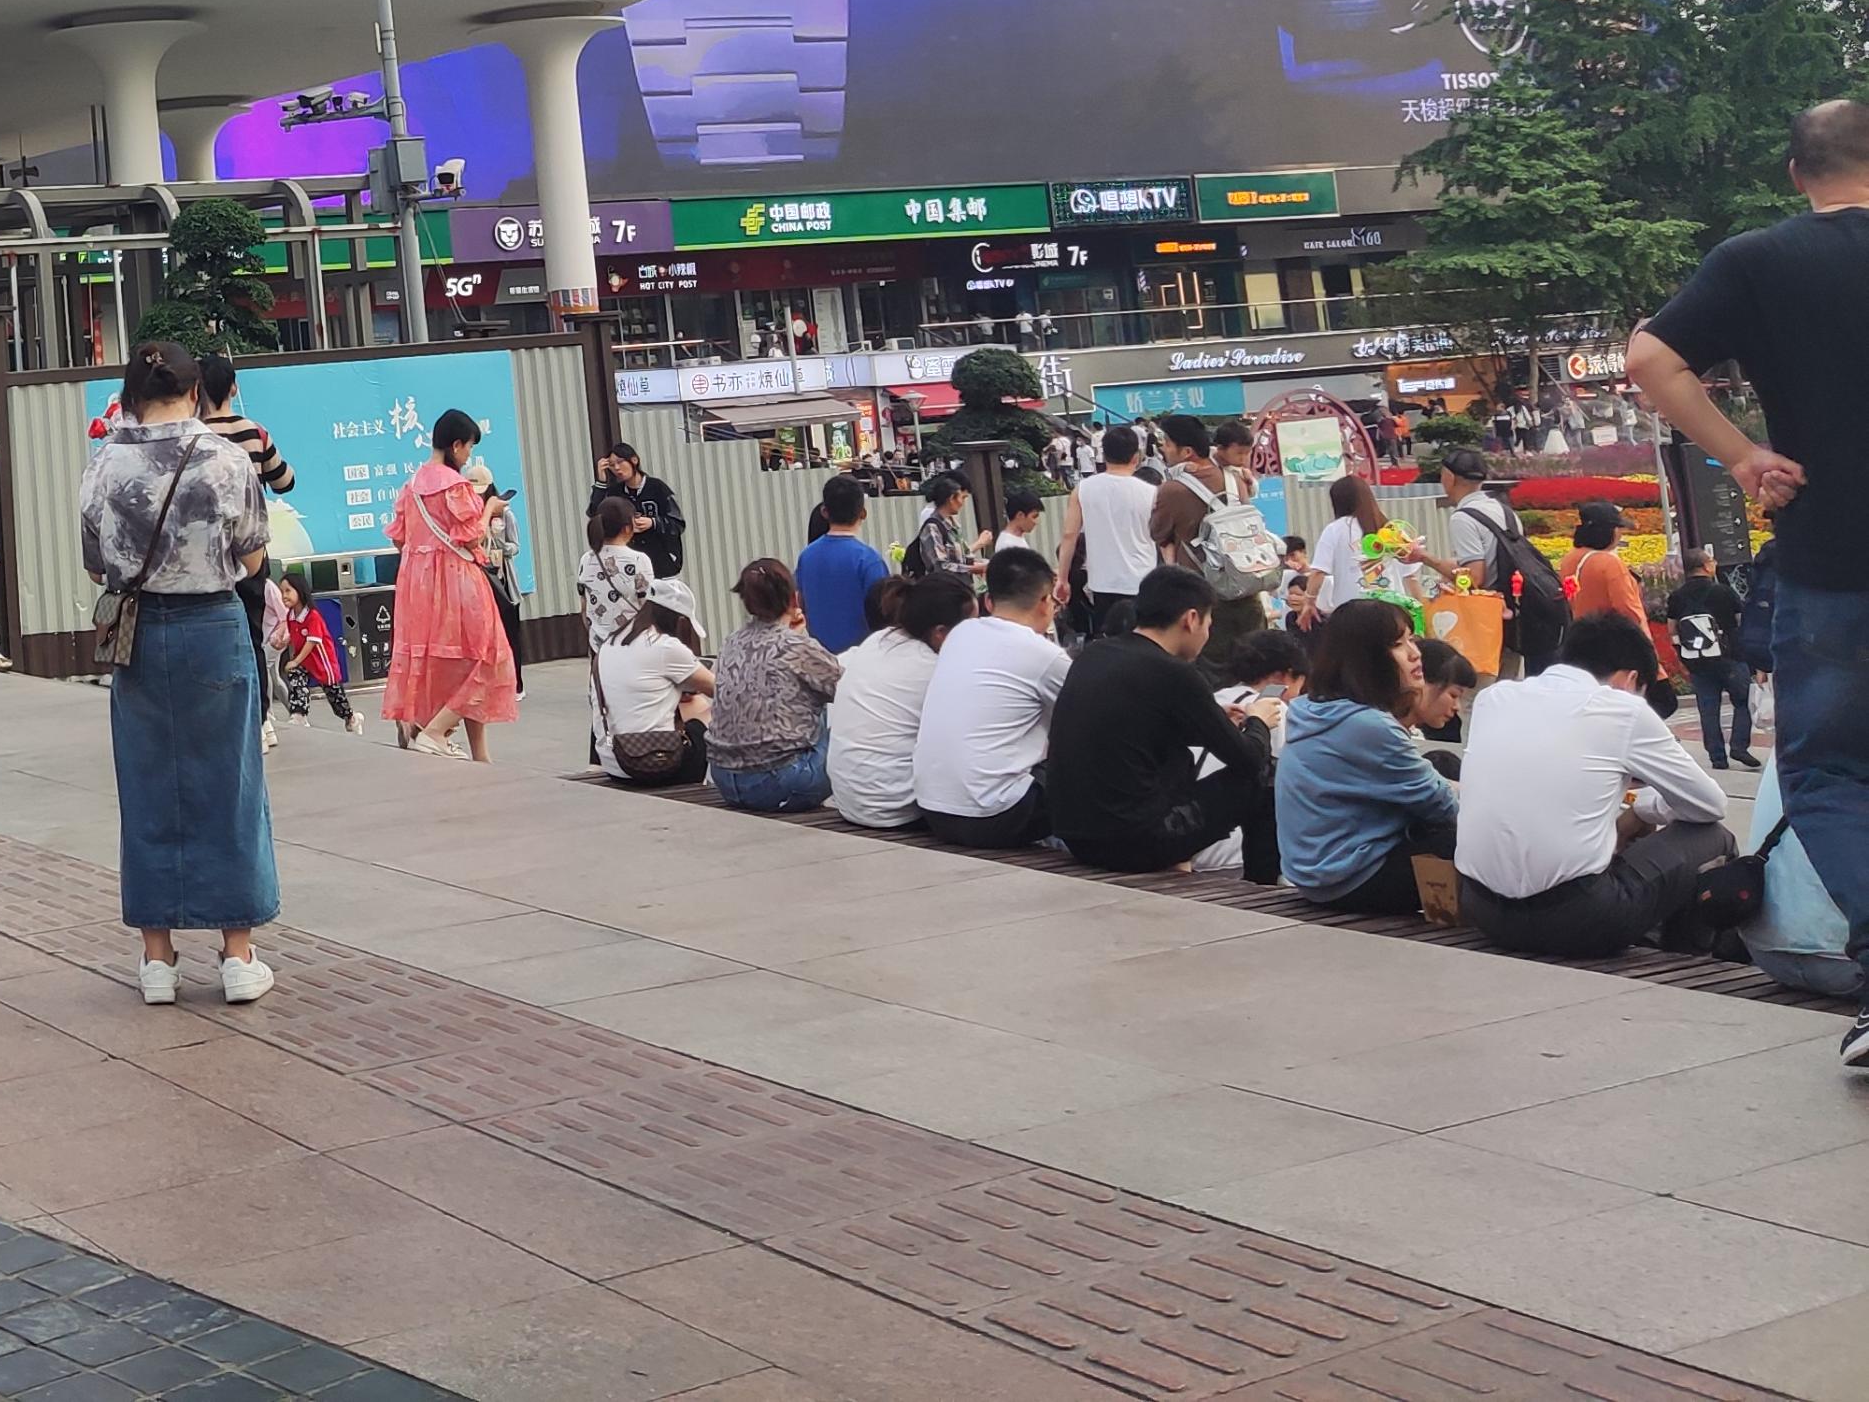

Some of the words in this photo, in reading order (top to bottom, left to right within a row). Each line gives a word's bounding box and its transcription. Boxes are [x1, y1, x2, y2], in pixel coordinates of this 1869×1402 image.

[768, 202, 832, 222] 中国邮政
[904, 196, 988, 225] 中国集邮
[611, 219, 637, 244] 7F
[770, 222, 805, 234] CHINA
[806, 219, 832, 232] POST
[1066, 245, 1089, 267] 7F
[639, 281, 655, 291] HOT
[657, 280, 675, 290] CITY
[678, 279, 698, 289] POST
[1230, 348, 1307, 367] Paradise
[332, 419, 385, 440] 社会主义
